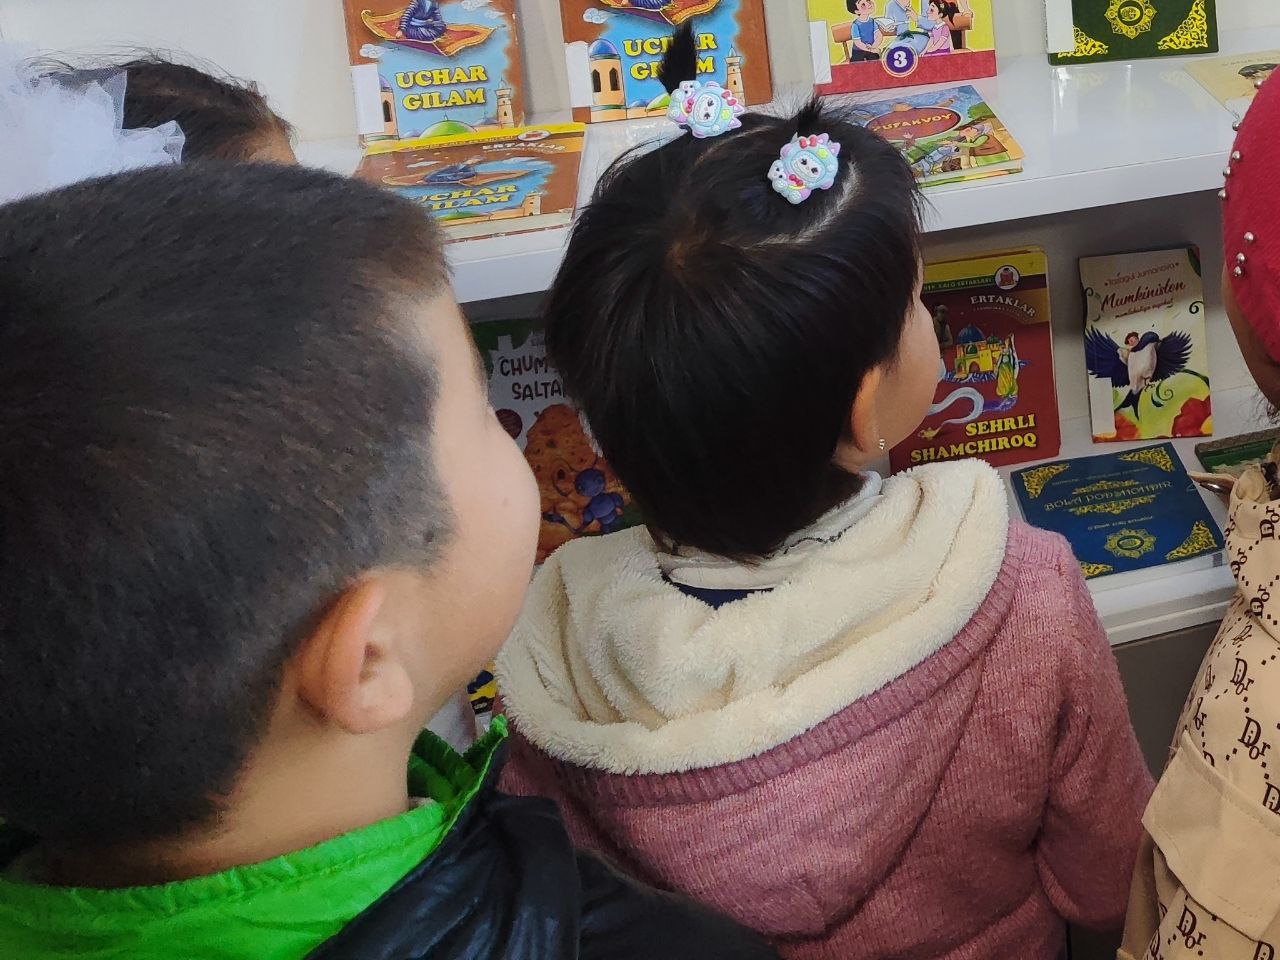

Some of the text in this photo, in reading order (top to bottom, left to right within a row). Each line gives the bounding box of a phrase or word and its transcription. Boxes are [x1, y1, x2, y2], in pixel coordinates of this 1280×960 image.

[630, 56, 714, 80] GIM
[893, 50, 908, 68] 3
[395, 65, 488, 89] UCHAR
[403, 88, 486, 111] GILAM
[431, 194, 511, 210] ILAM
[970, 294, 1036, 317] ERTAKLAR
[1101, 278, 1186, 312] Mumkiniston
[499, 354, 553, 377] CHUM
[512, 378, 566, 401] SALTA
[965, 413, 1036, 437] SEHRLI
[910, 432, 1037, 462] SHAMCHIROQ
